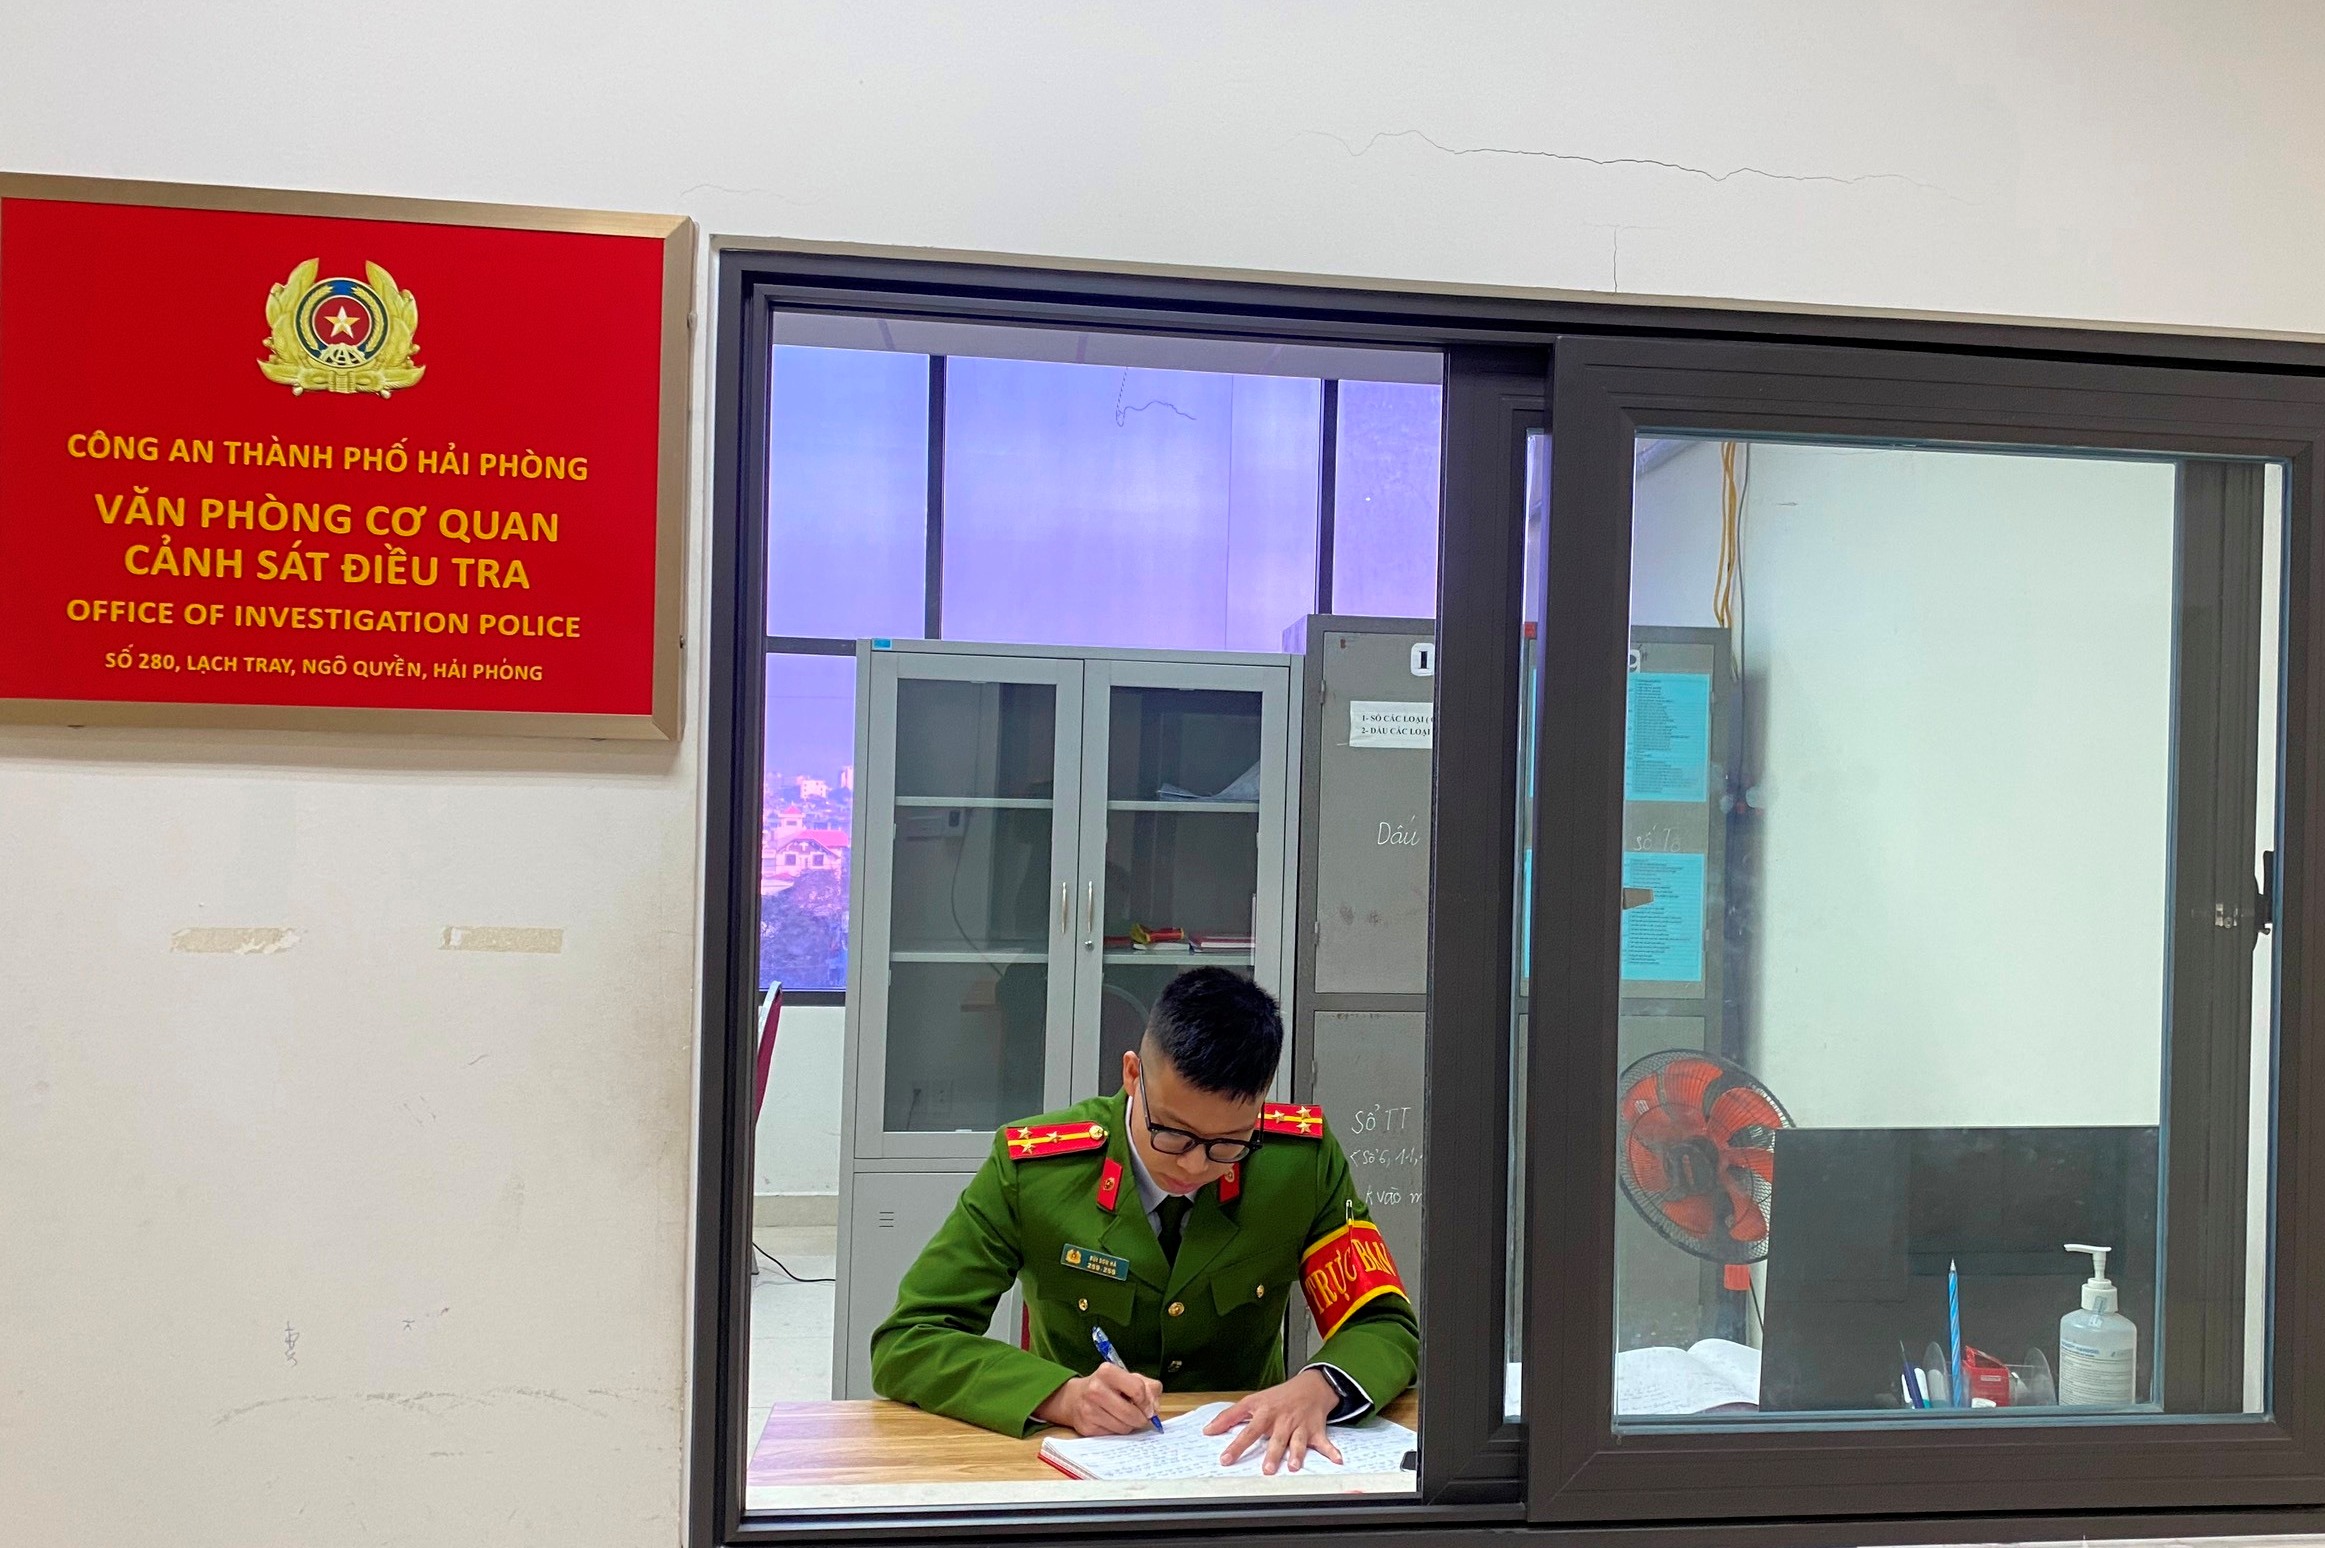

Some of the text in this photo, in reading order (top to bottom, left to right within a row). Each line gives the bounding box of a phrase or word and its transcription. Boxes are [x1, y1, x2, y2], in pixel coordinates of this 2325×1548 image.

[67, 429, 588, 481] CÔNG AN THÀNH PHỐ HẢI PHÒNG
[94, 485, 558, 544] VĂN PHÒNG CƠ QUAN
[124, 533, 530, 590] CẢNH SÁT ĐIỀU TRA
[66, 599, 581, 638] OFFICE OF INVESTIGATION POLICE
[105, 643, 134, 669] SỐ
[138, 653, 181, 673] 280,
[187, 655, 238, 675] LẠCH
[243, 656, 296, 677] TRAY,
[302, 654, 348, 675] NGÔ
[352, 654, 427, 680] QUYỀN,
[433, 658, 467, 679] HẢI
